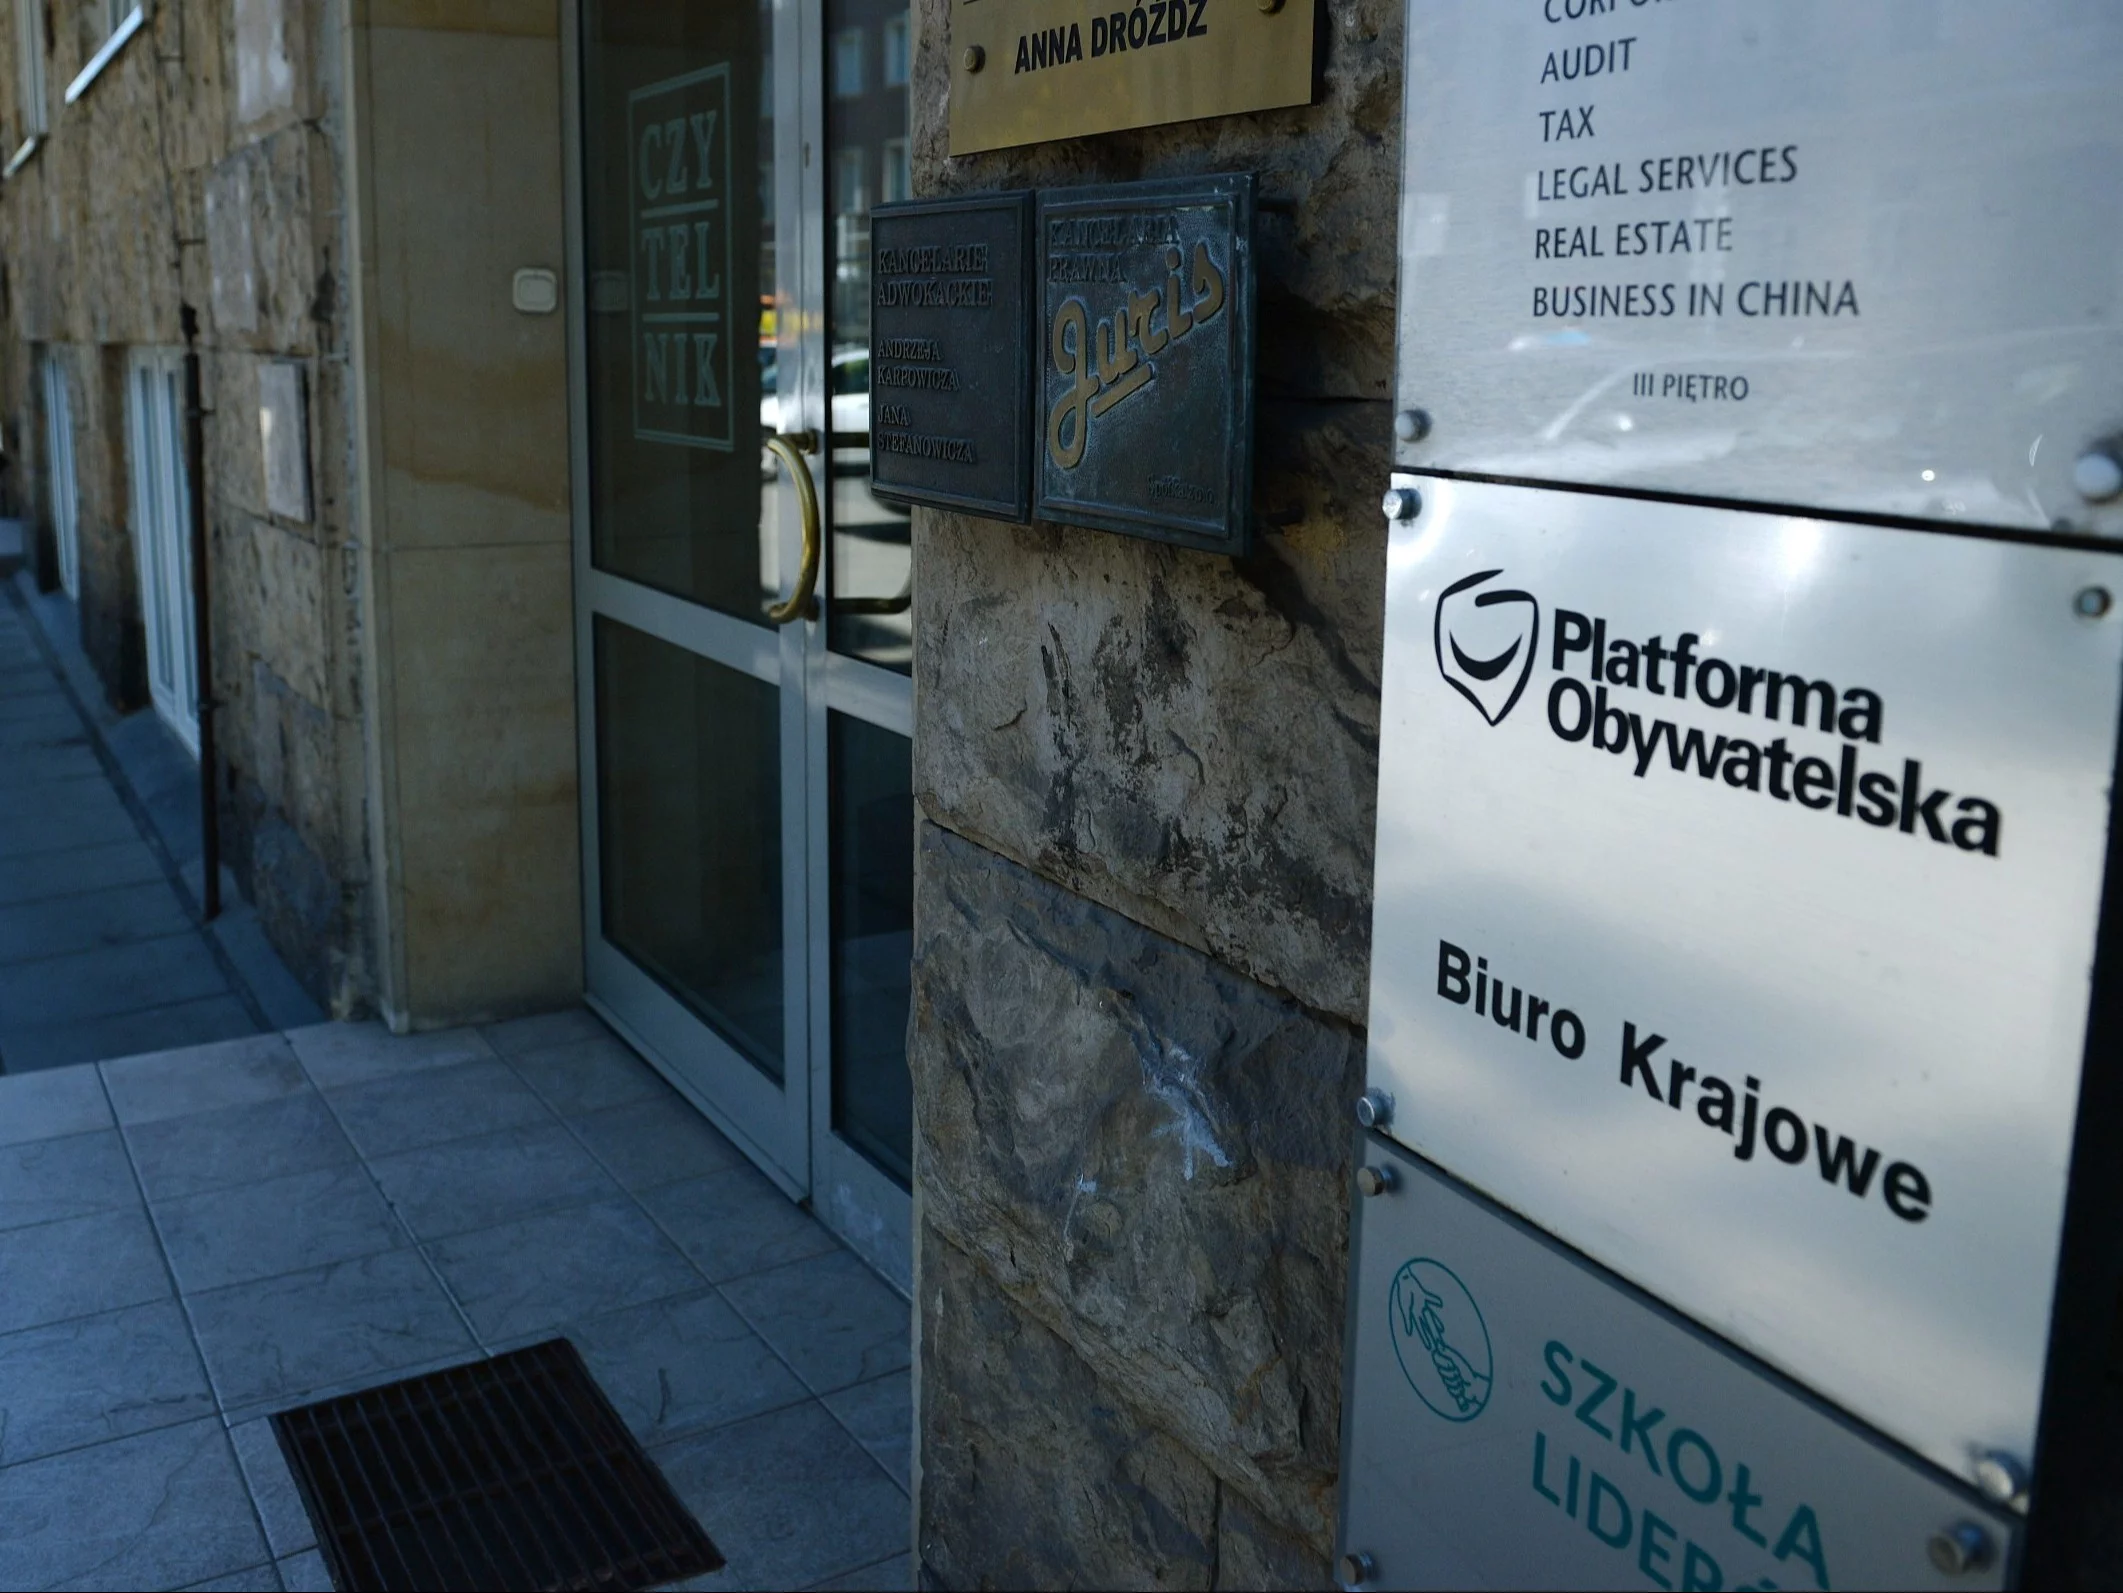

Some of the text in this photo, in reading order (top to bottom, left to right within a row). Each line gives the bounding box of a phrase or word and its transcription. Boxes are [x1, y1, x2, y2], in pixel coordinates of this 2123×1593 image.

[1014, 23, 1083, 74] ANNA
[1540, 37, 1637, 84] AUDIT
[1539, 105, 1595, 142] TAX
[639, 110, 717, 199] CZY
[1537, 145, 1798, 202] LEGAL SERVICES
[641, 221, 720, 300] TEL
[877, 243, 988, 274] KANCELARIE
[1535, 217, 1732, 259] REAL ESTATE
[1048, 252, 1127, 283] PRAWNA
[877, 279, 993, 308] ADWOKACKIE
[1533, 280, 1860, 317] BUSINESS IN CHINA
[644, 332, 722, 407] NIK
[877, 338, 943, 362] ANDRZEJA
[1047, 242, 1225, 470] Juris
[877, 365, 960, 392] KARPOWICZA
[1633, 372, 1749, 402] III PIĘTRO
[877, 403, 911, 427] JANA
[877, 431, 976, 465] STEFANOWICZA
[1552, 608, 1884, 744] Platforma
[1548, 677, 2000, 858] Obywatelska
[1437, 939, 1933, 1224] Biuro Krajowe
[1540, 1339, 1831, 1591] SZKOŁA
[1532, 1430, 1779, 1592] LIDER
